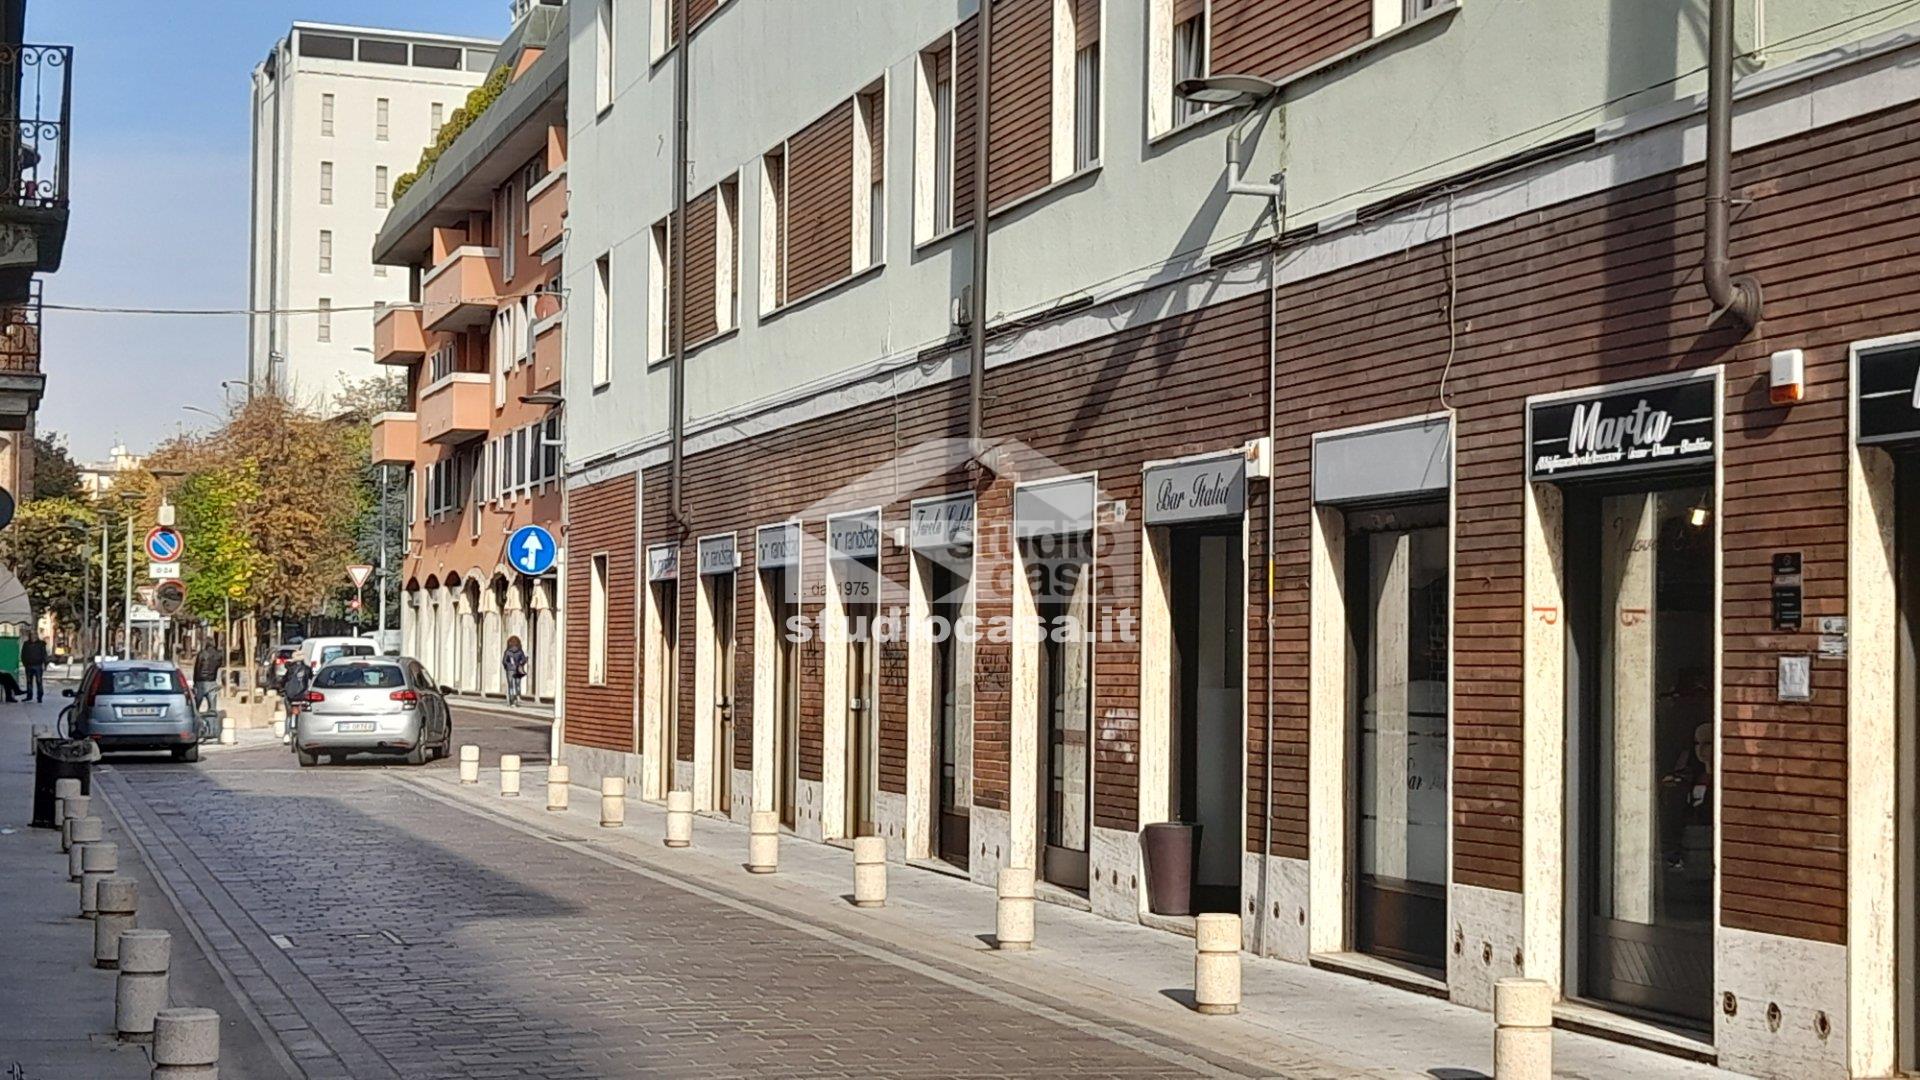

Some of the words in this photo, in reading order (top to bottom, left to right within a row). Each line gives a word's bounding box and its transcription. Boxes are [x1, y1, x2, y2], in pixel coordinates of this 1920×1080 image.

[1568, 399, 1673, 454] Marta
[1157, 478, 1185, 511] Bar
[1189, 472, 1230, 508] Italia
[153, 676, 165, 687] P
